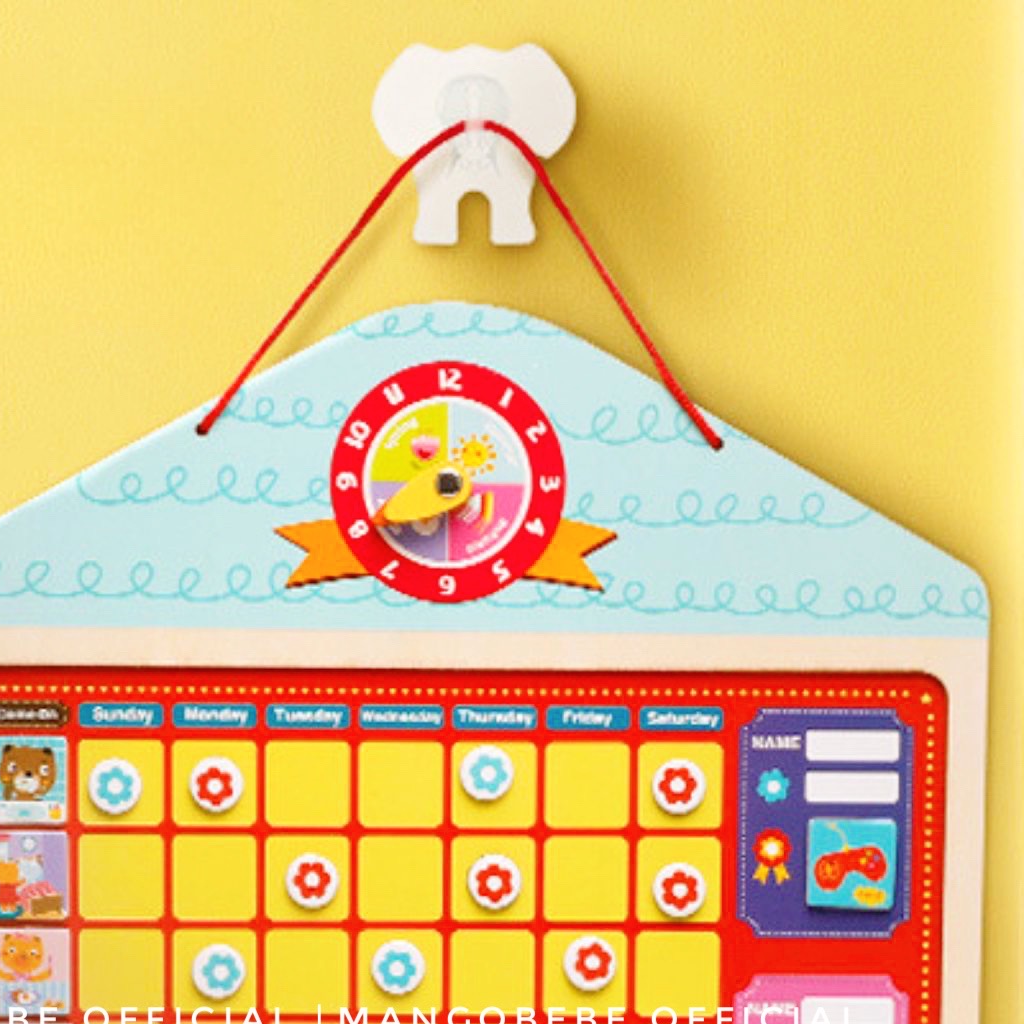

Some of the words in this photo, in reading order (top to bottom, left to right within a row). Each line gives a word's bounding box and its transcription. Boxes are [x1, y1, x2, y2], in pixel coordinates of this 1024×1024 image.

[438, 368, 462, 390] 12
[499, 387, 514, 408] 1
[344, 420, 371, 449] 10
[526, 422, 546, 443] 2
[336, 471, 358, 491] 9
[540, 475, 560, 492] 3
[348, 519, 368, 539] 8
[526, 518, 545, 536] 4
[379, 560, 399, 580] 7
[492, 559, 511, 583] 5
[438, 575, 456, 595] 6
[92, 706, 154, 725] Sunday
[184, 706, 249, 725] Monday
[274, 708, 343, 726] Tuesday
[362, 709, 443, 726] Wednesday
[458, 709, 536, 727] Thursday
[562, 709, 613, 727] Friday
[647, 710, 720, 727] Saturday
[751, 735, 801, 750] NAME
